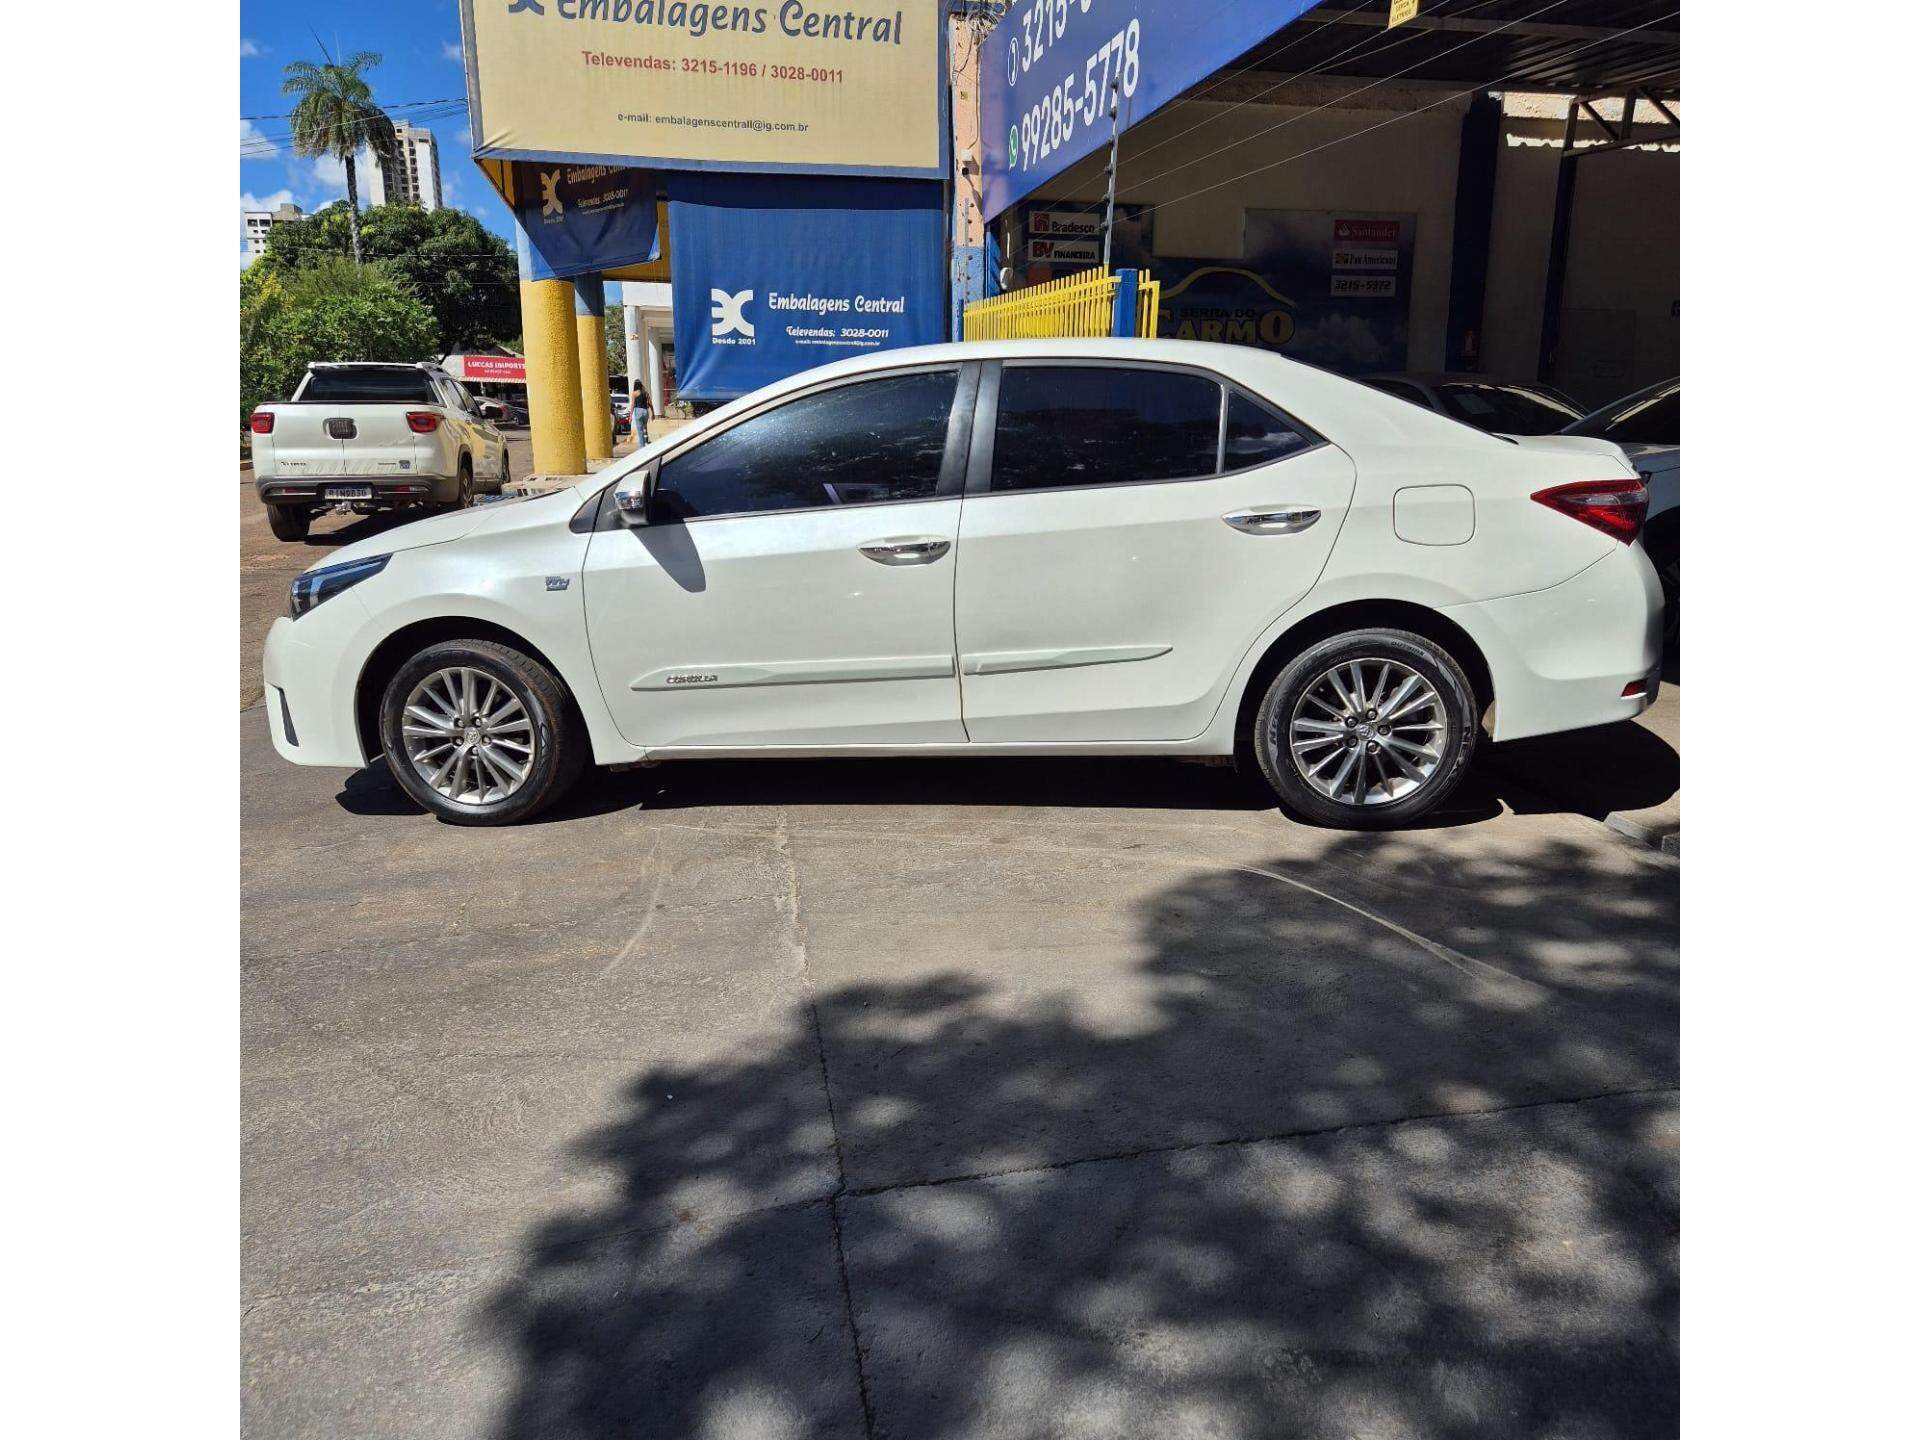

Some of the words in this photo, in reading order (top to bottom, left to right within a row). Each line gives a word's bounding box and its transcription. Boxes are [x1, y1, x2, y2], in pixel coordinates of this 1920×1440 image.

[779, 0, 902, 44] Central
[581, 50, 676, 71] Televendas:
[681, 58, 757, 77] 3215-1196
[761, 64, 766, 77] /
[771, 65, 843, 83] 3028-0011
[1021, 18, 1140, 172] 99285-5778
[617, 112, 651, 124] e-mail:
[1052, 221, 1095, 234] Bradesco
[1352, 225, 1397, 238] Santander
[768, 292, 850, 315] Embalagens
[854, 295, 904, 313] Central
[786, 325, 836, 338] Televendas:
[840, 327, 889, 338] 3028-0011
[738, 337, 756, 345] 2001
